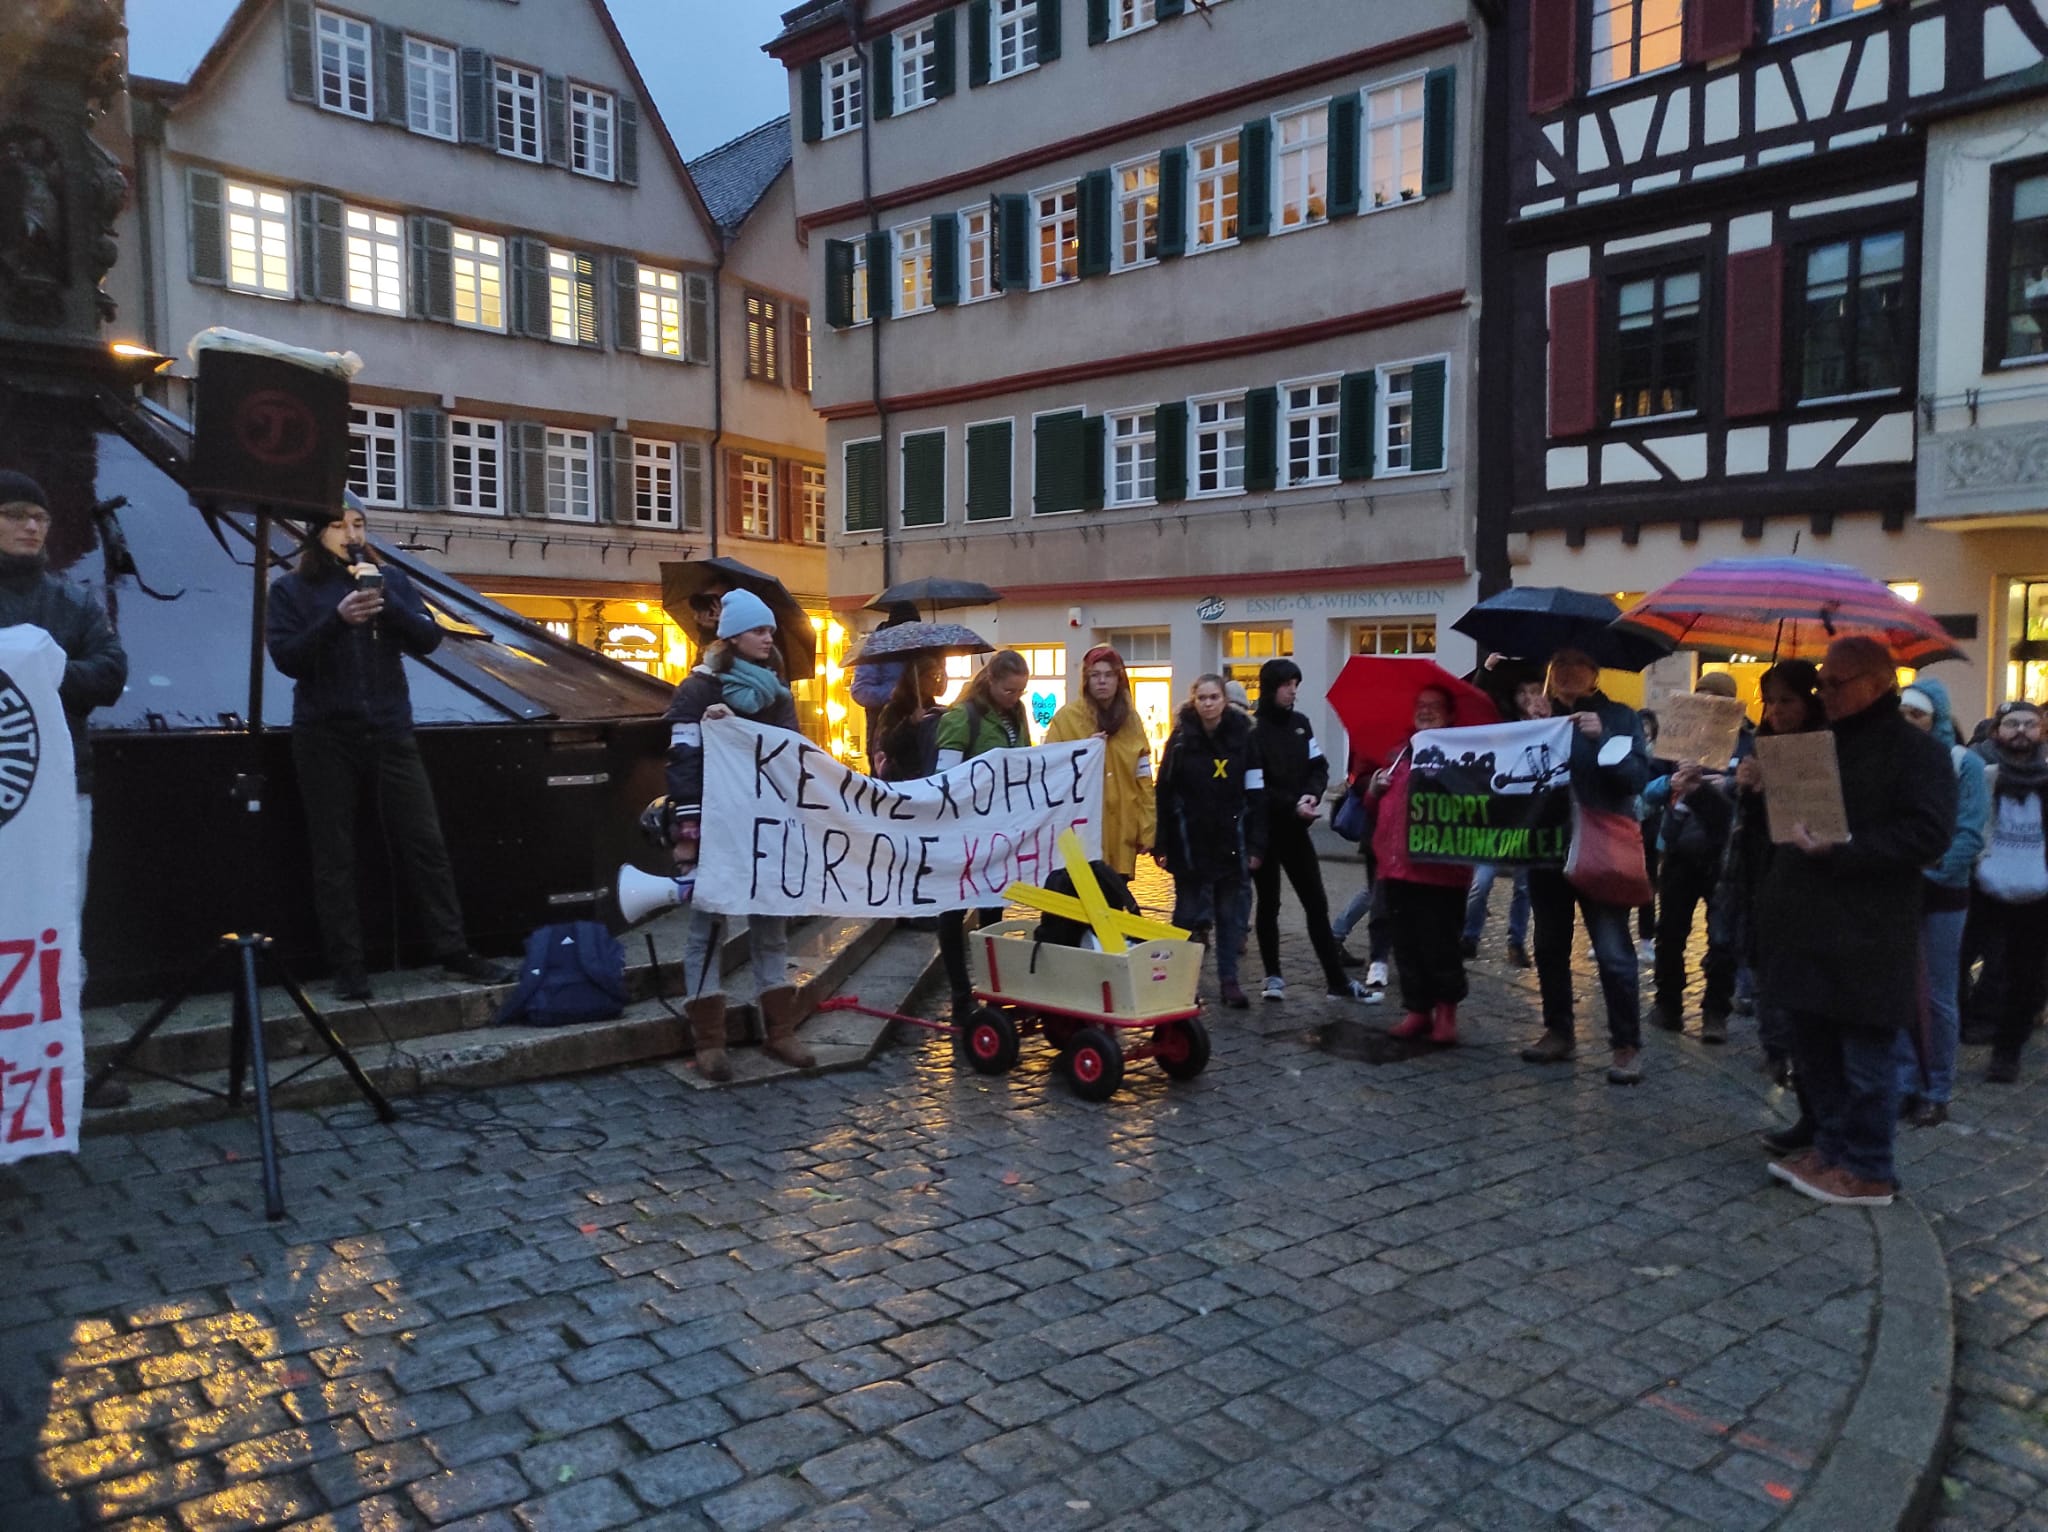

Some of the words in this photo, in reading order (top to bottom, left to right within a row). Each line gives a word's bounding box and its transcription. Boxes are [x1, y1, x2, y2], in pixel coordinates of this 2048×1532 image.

[1200, 600, 1226, 619] FASS
[1246, 597, 1288, 613] ESSIG
[1324, 591, 1389, 609] WHISKY
[1399, 589, 1445, 606] WEIN
[926, 748, 1088, 820] KOHLE
[1410, 792, 1490, 824] STOPPT
[1408, 823, 1564, 858] BRAUNKOHLE!
[750, 817, 850, 904] FÜR
[867, 833, 940, 906] DIE
